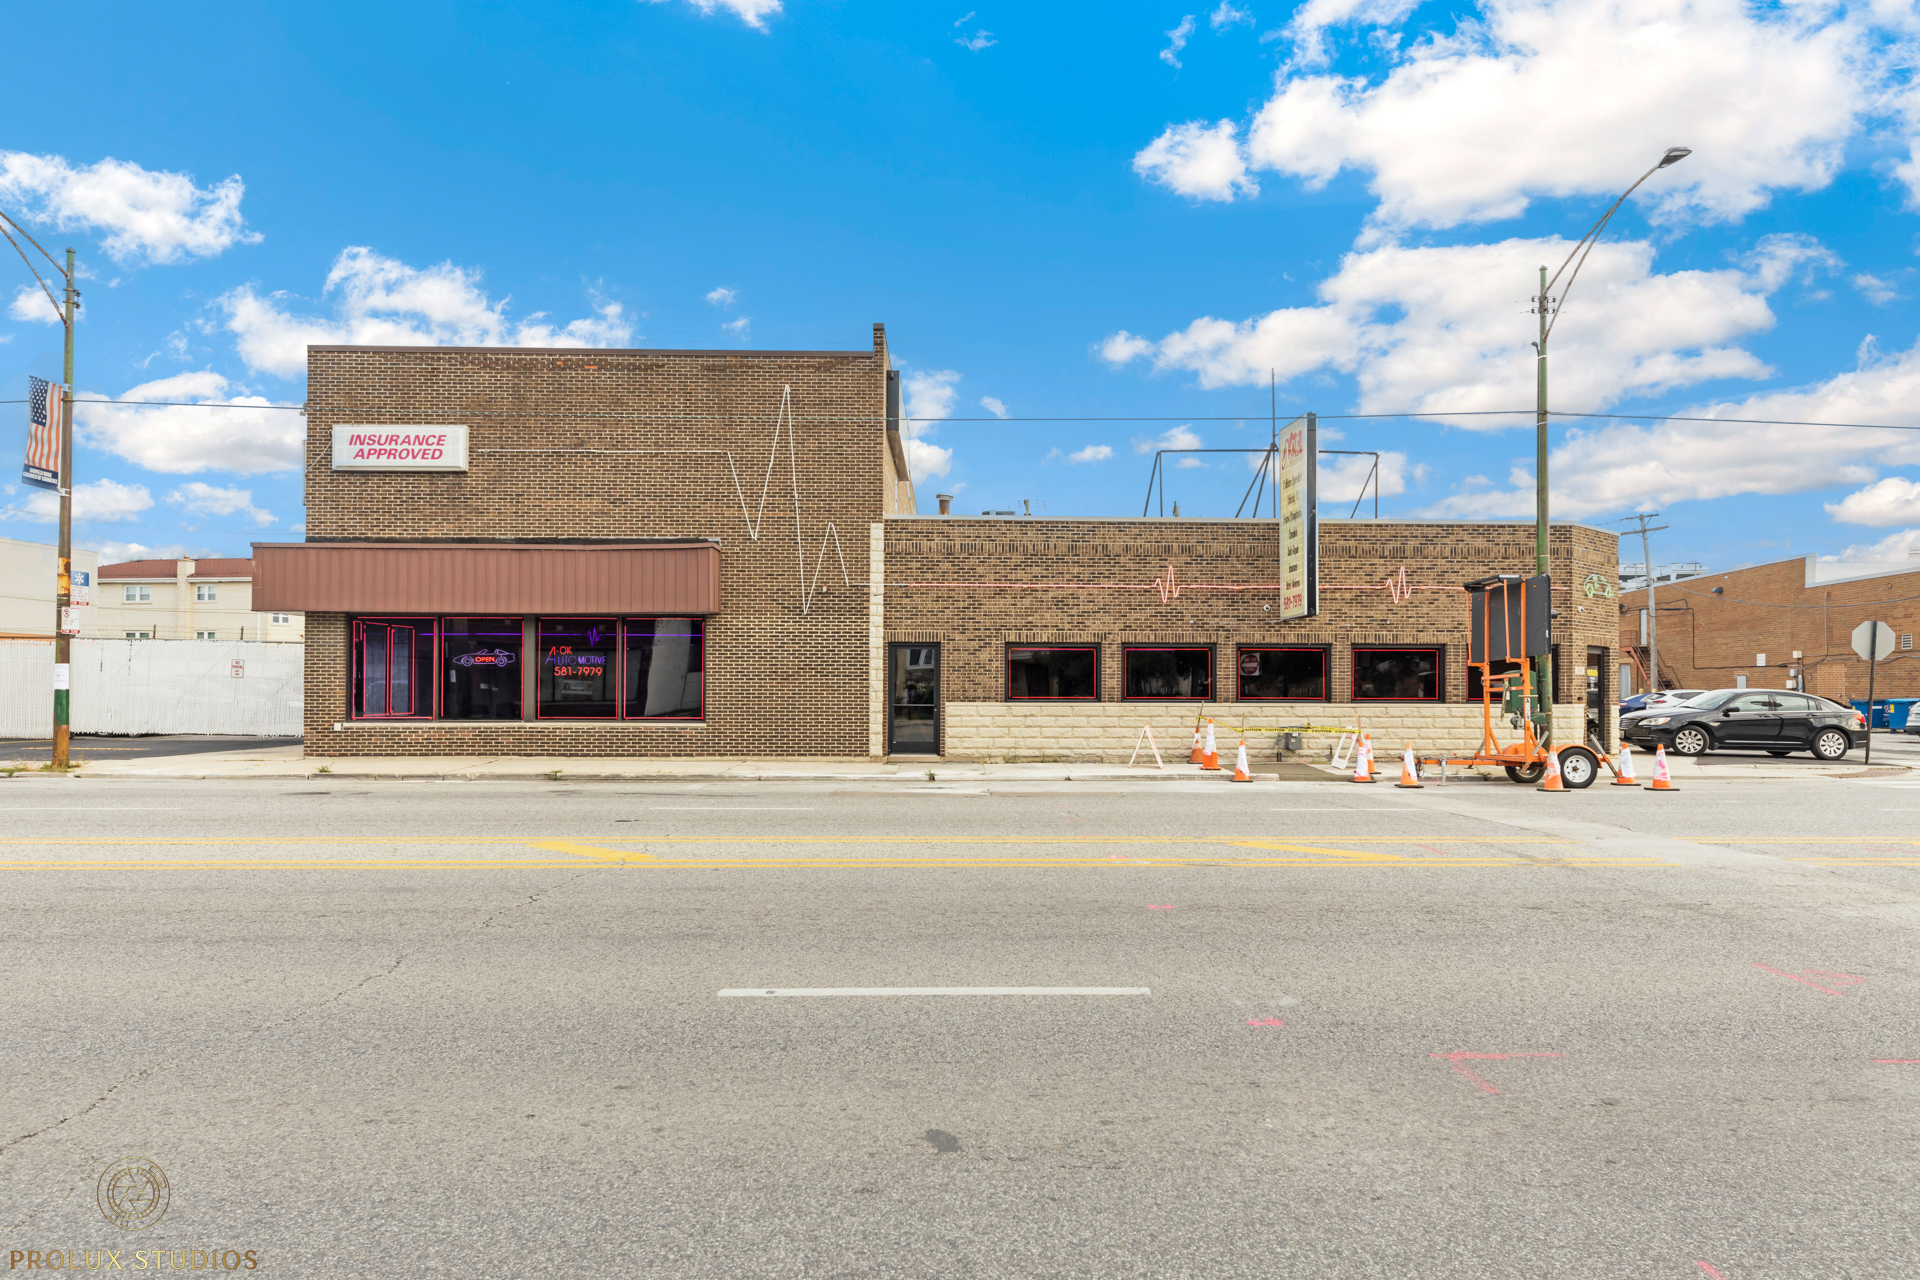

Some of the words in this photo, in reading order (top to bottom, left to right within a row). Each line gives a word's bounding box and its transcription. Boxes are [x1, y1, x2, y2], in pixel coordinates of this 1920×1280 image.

[348, 434, 448, 446] INSURANCE
[352, 447, 444, 460] APPROVED
[1283, 593, 1303, 611] 581-7979
[553, 666, 603, 676] 581-7979
